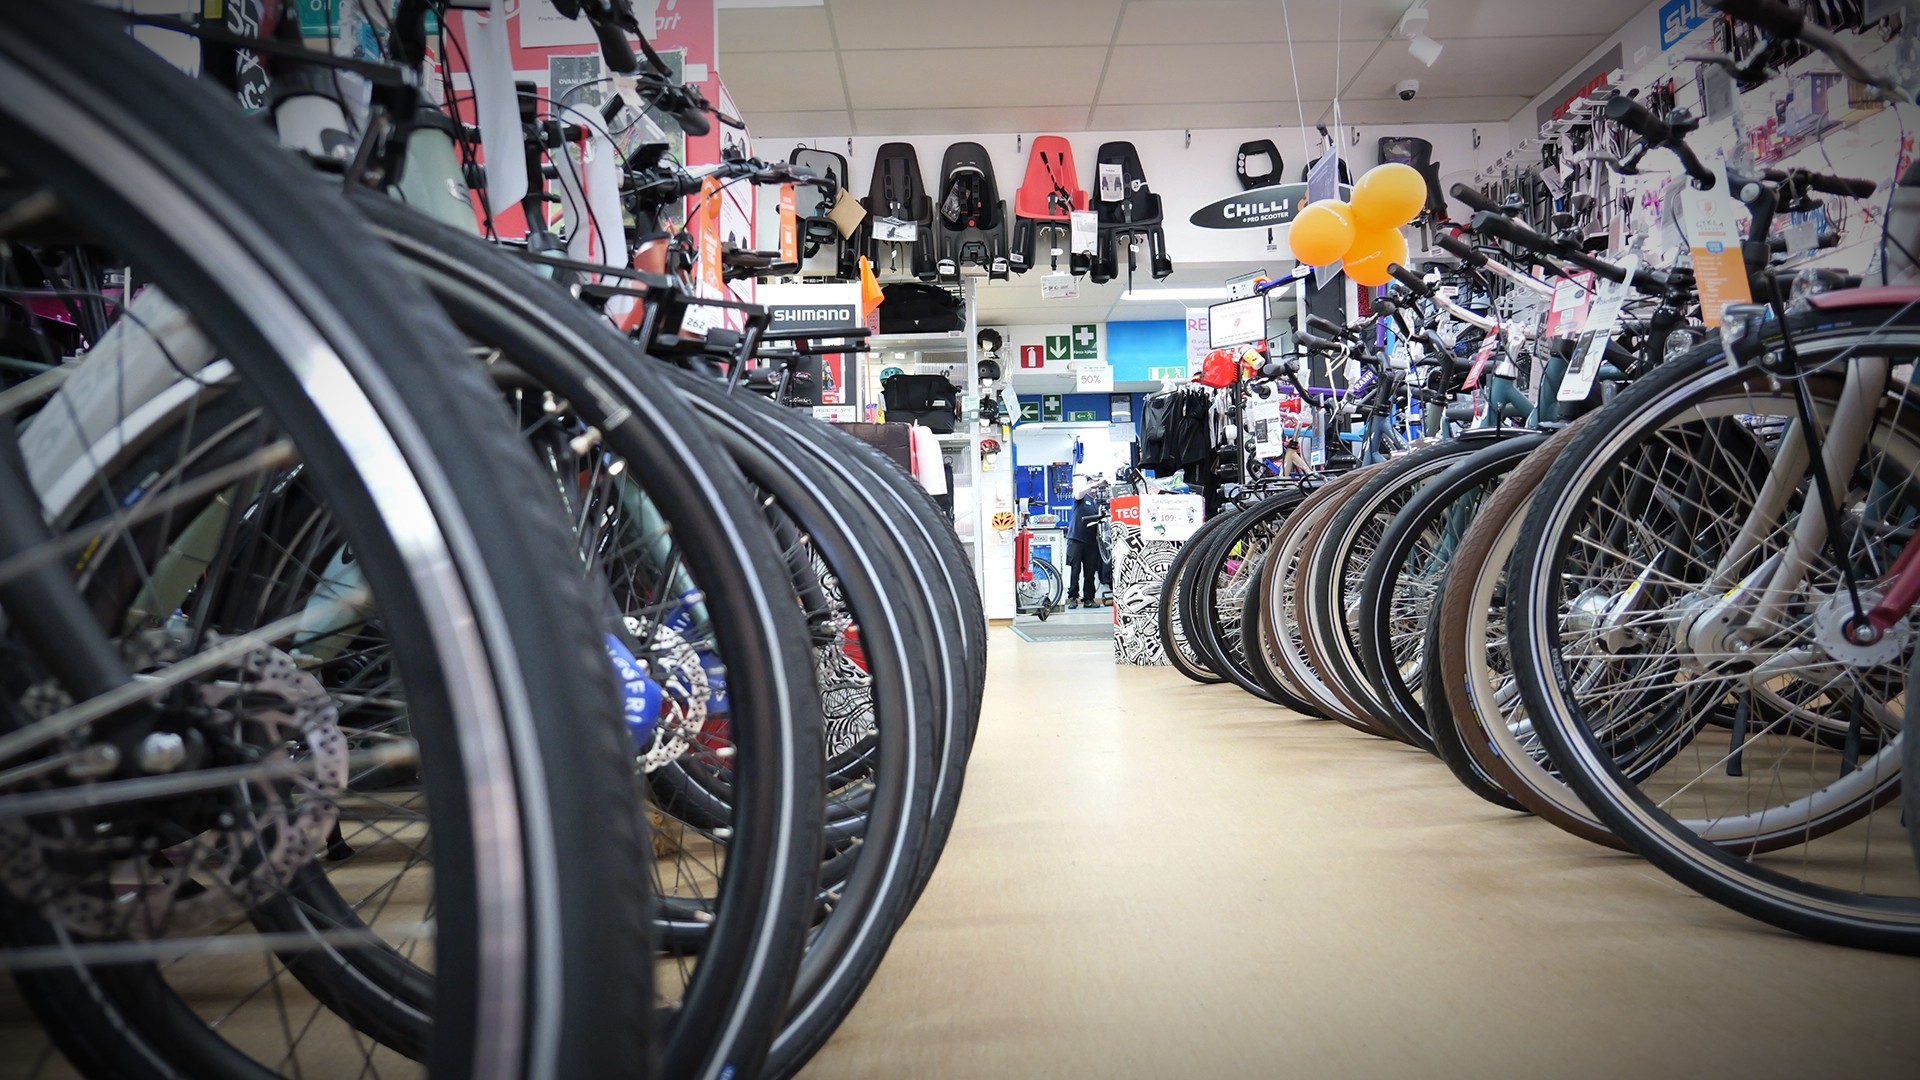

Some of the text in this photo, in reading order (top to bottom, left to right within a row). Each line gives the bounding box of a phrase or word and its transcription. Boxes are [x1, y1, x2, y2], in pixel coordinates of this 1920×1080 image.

[1223, 198, 1289, 219] CHILLI
[1260, 211, 1289, 221] SCOOTER
[774, 309, 850, 321] SHIMANO
[686, 317, 706, 329] 262
[1081, 375, 1102, 384] 50%
